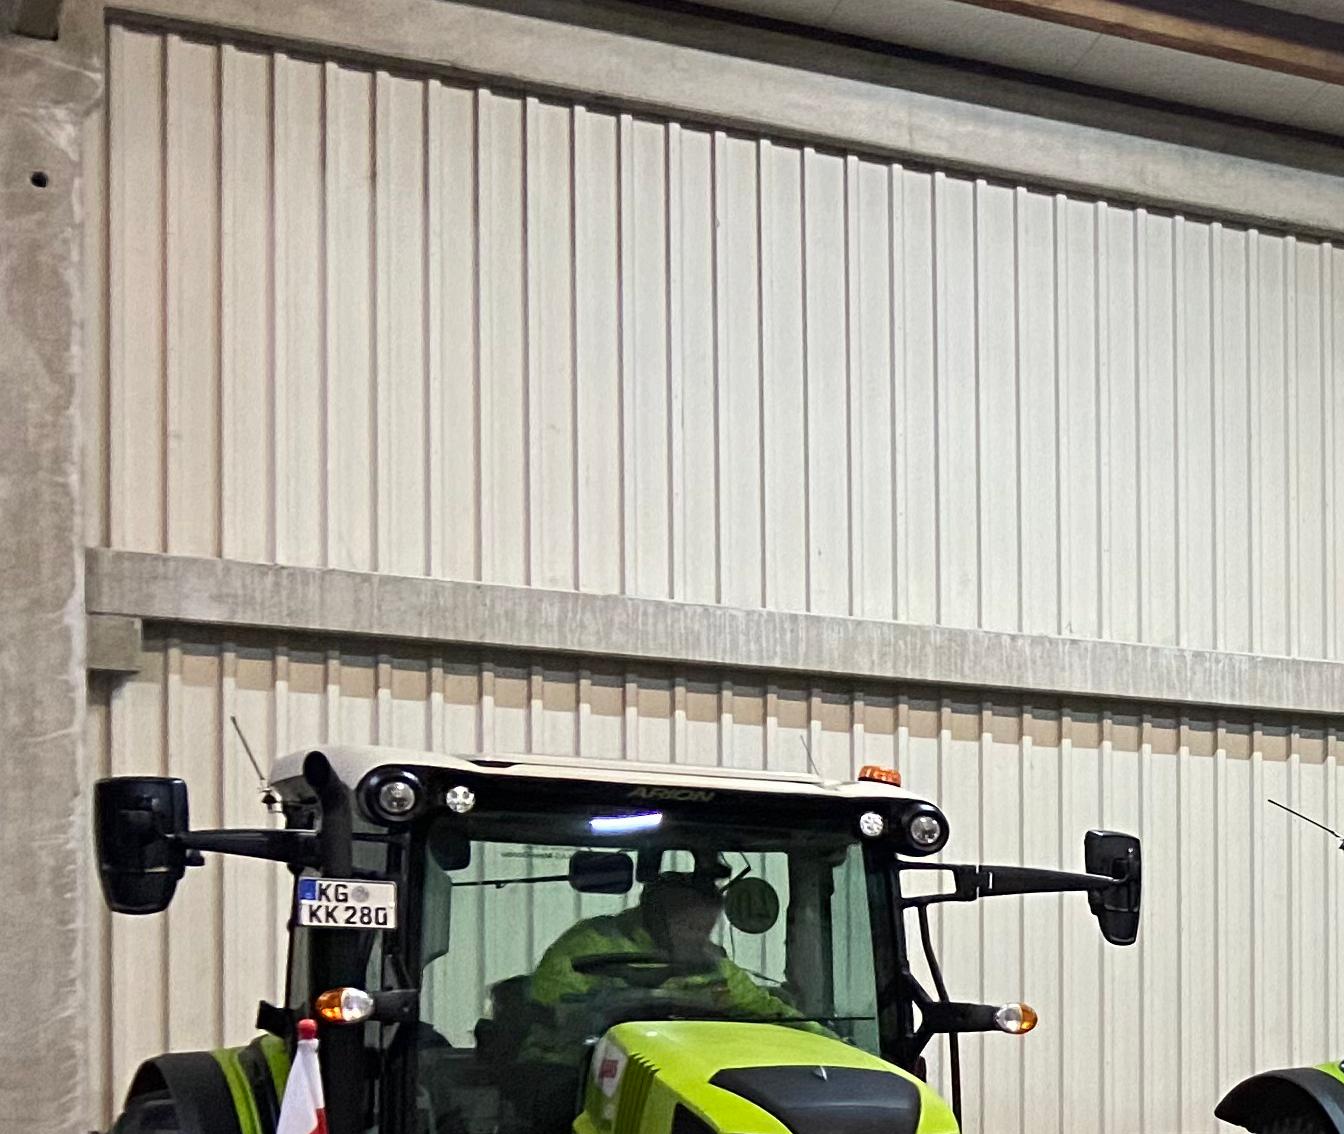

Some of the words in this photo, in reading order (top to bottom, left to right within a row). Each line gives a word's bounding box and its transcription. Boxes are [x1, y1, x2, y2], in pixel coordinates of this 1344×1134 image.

[318, 883, 349, 903] KG
[308, 904, 339, 925] KK
[344, 905, 388, 926] 280
